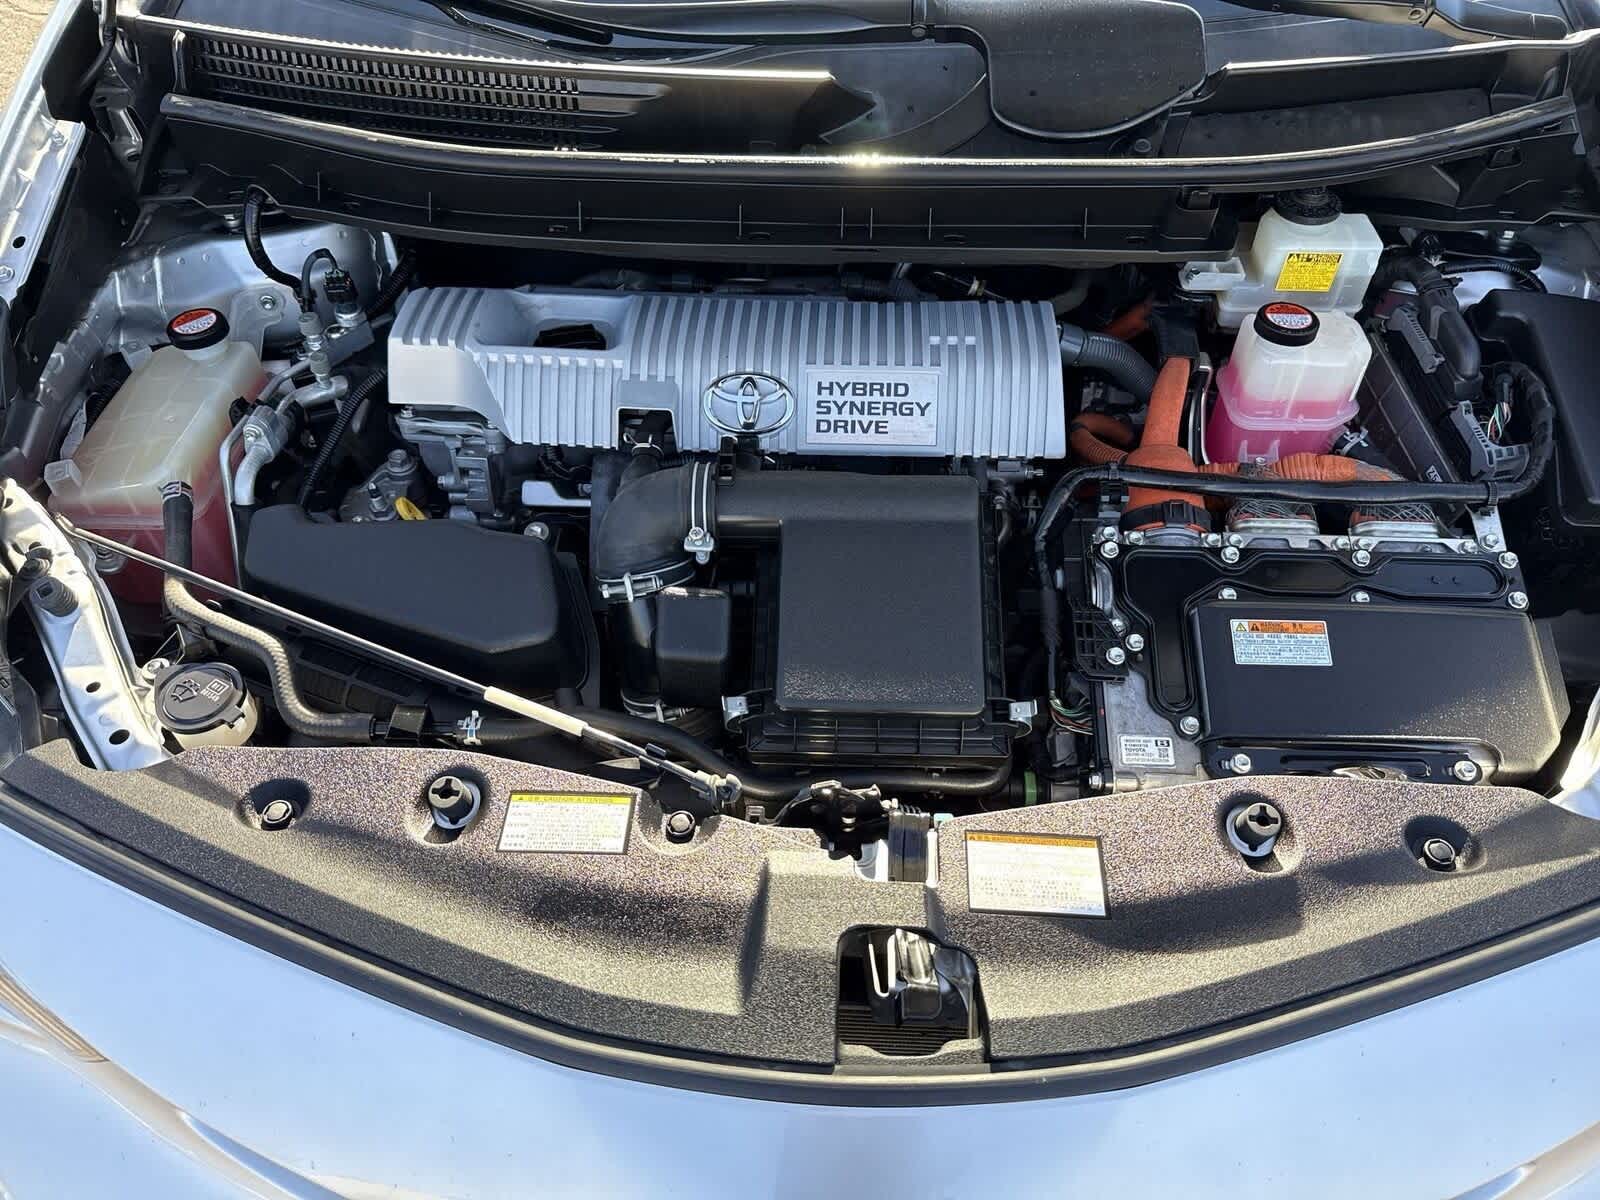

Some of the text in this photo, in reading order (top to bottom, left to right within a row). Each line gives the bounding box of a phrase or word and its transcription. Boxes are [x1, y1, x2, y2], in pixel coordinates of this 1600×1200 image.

[816, 381, 910, 398] HYBRID
[815, 400, 932, 417] SYNERGY
[815, 419, 889, 434] DRIVE
